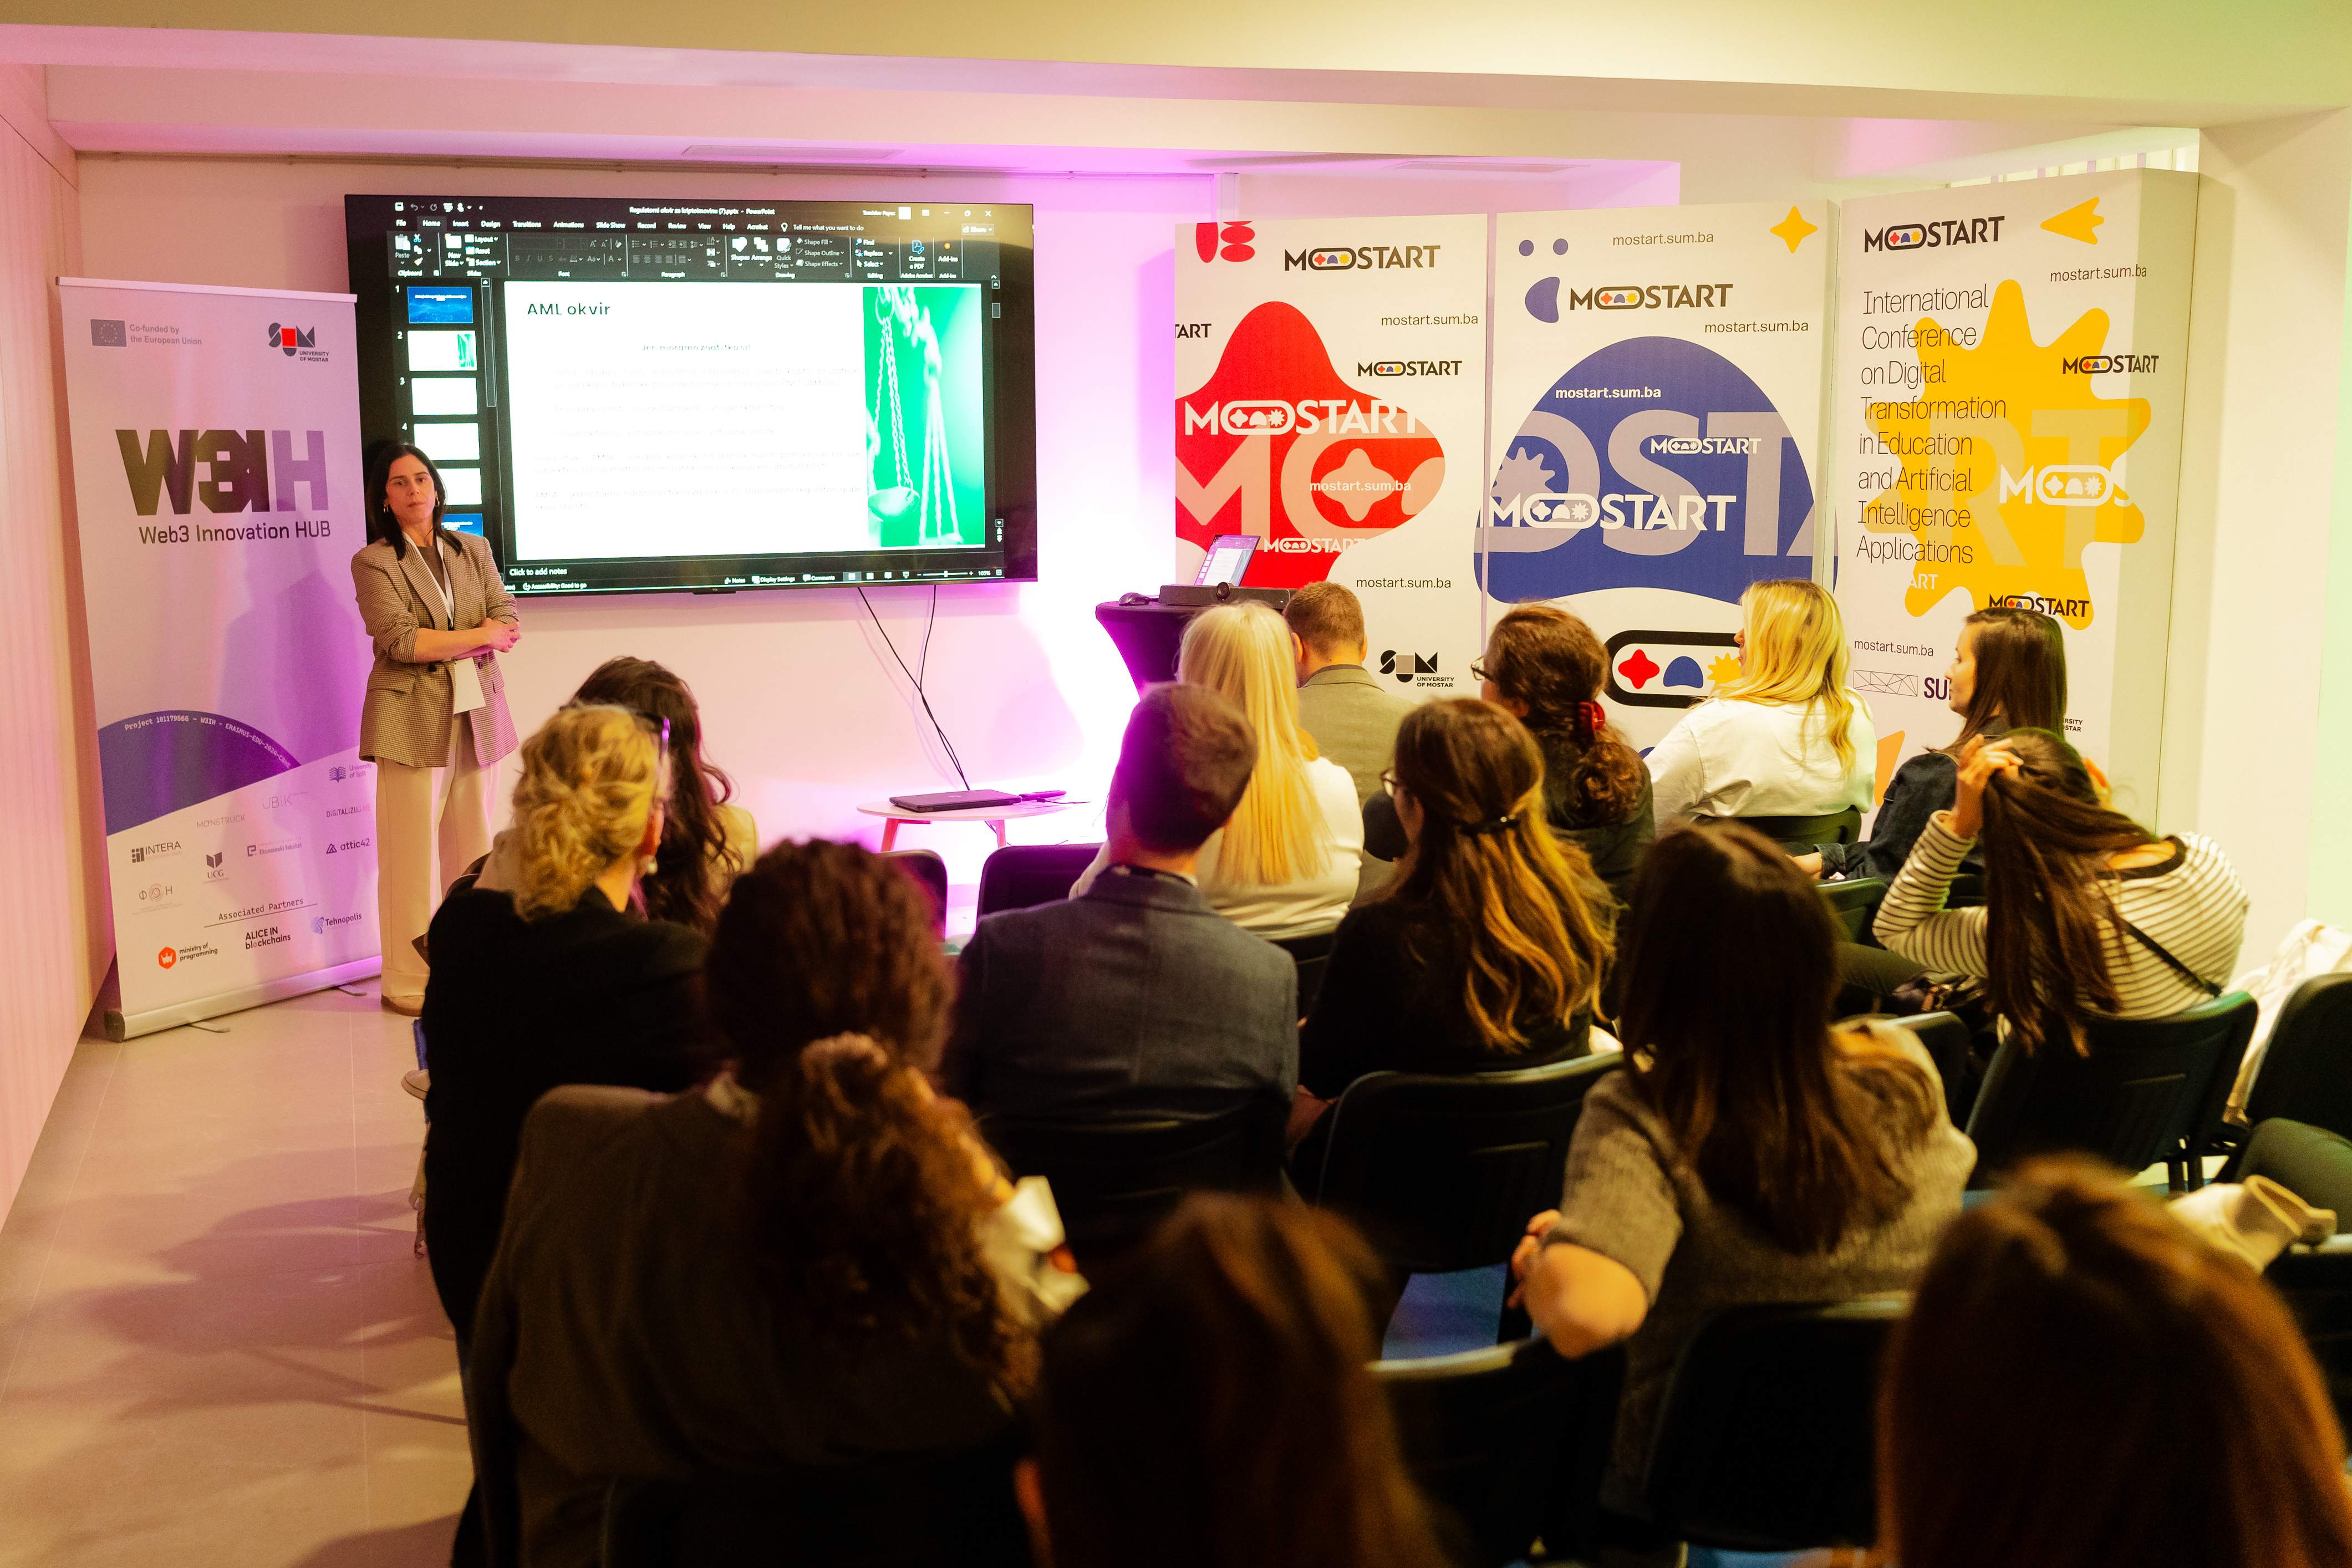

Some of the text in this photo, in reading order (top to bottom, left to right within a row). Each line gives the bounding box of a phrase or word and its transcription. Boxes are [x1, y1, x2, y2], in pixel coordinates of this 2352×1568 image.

[1612, 232, 1714, 246] mostart.sum.ba
[2050, 264, 2147, 282] mostart.sum.ba
[1863, 284, 1989, 315] International
[527, 302, 610, 315] AML okvir
[1381, 314, 1479, 326] mostart.sum.ba
[1704, 320, 1809, 334] mostart.sum.ba
[130, 324, 179, 334] Co-funded by
[397, 331, 403, 339] 2
[144, 336, 180, 344] European
[1862, 324, 1977, 350] Conference
[400, 377, 405, 385] 3
[1861, 360, 1947, 389] on Digital
[1555, 387, 1662, 399] mostart.sum.ba
[1860, 396, 2007, 420] Transformation
[402, 422, 407, 431] 4
[1860, 431, 1973, 456] in Education
[1310, 481, 1411, 492] mostart.sum.ba
[1858, 467, 1973, 492] and Artificial
[1857, 501, 1971, 531] Intelligence
[139, 521, 331, 544] Web3 Innovation HUB
[1856, 535, 1973, 564] Applications
[1356, 578, 1452, 589] mostart.sum.ba
[1854, 639, 1934, 658] mostart.sum.ba
[1923, 677, 1951, 701] SU
[125, 718, 153, 731] Project
[156, 715, 189, 724] 101179566
[201, 717, 216, 726] W3IH
[349, 763, 372, 771] University
[145, 841, 181, 854] INTERA
[340, 838, 370, 851] attic42
[207, 869, 224, 879] UCG
[219, 898, 304, 921] Associated Partners
[325, 913, 362, 926] Tehnopolis
[246, 926, 278, 941] ALICE IN
[246, 934, 291, 949] blockchains
[179, 944, 202, 954] ministry
[180, 948, 218, 962] programming
